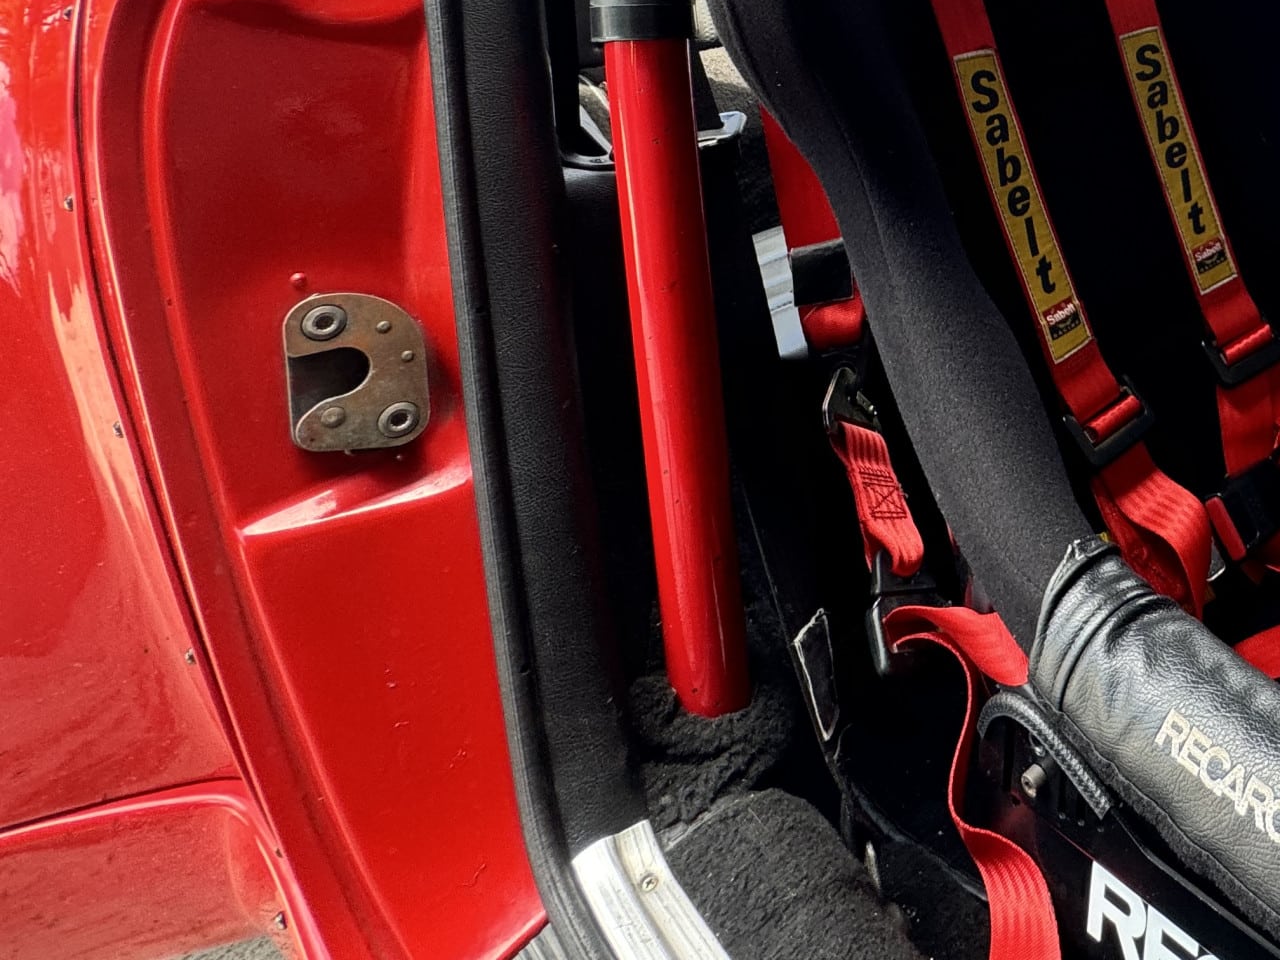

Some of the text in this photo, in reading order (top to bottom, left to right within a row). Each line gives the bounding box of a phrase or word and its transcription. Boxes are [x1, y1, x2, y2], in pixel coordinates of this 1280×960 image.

[970, 69, 1056, 295] Sabelt
[1135, 43, 1206, 235] Sabelt
[1086, 860, 1222, 960] RE
